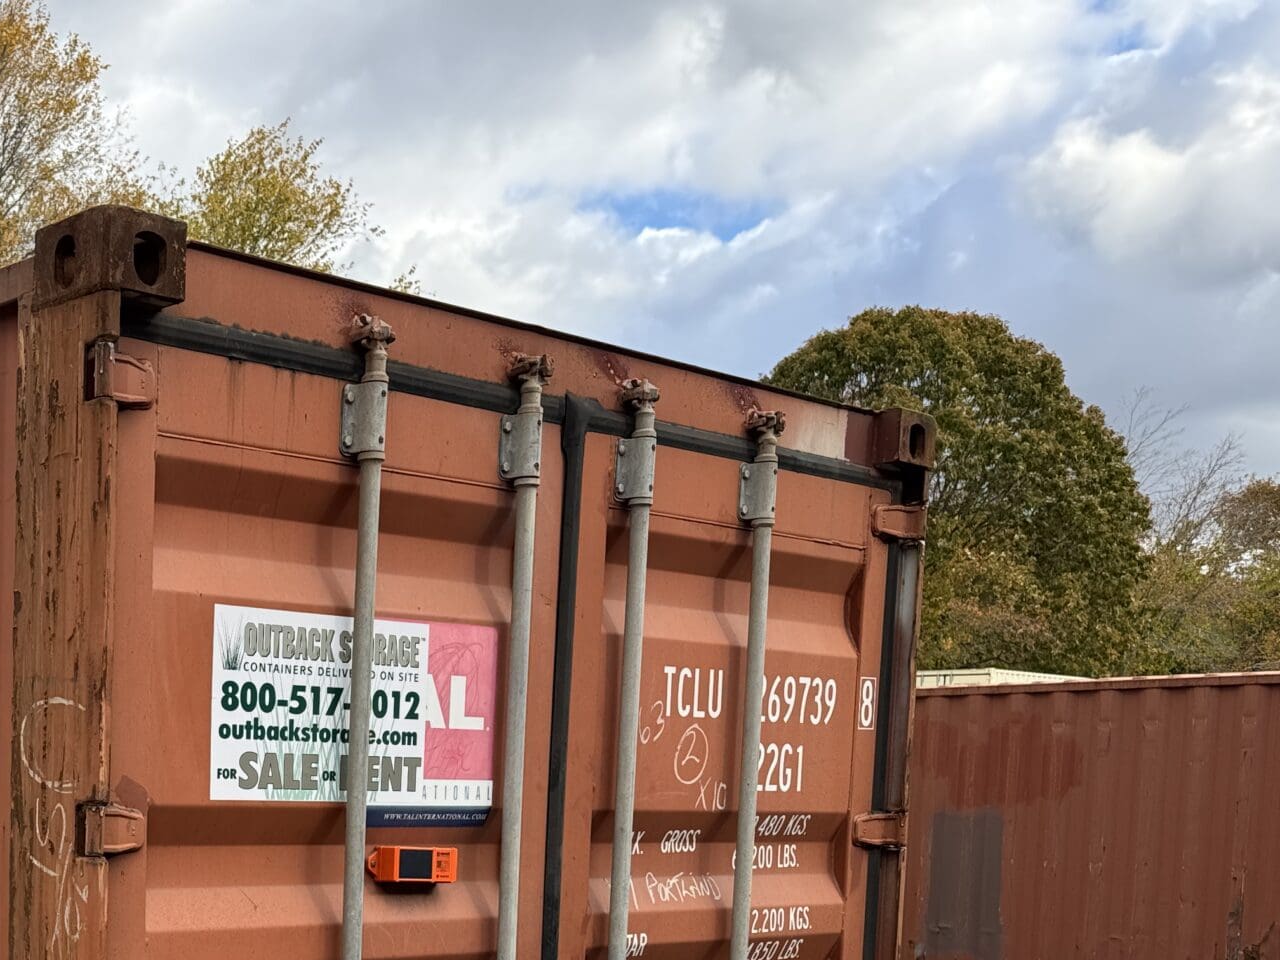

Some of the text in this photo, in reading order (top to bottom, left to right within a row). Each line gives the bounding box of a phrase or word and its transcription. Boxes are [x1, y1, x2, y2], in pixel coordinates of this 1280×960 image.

[243, 622, 420, 668] OUTBACK SRAGE
[243, 661, 419, 683] CONTAINERS DELIVED ON SITE
[220, 680, 420, 720] 800-517-012
[664, 666, 723, 719] TCLU
[860, 680, 873, 727] 8
[218, 717, 418, 746] outbackstorae.com
[217, 768, 237, 780] FOR
[238, 751, 319, 790] SALE
[322, 770, 336, 782] OR
[660, 829, 701, 853] GROSS
[783, 814, 811, 836] KGS.
[777, 844, 800, 868] LBS.
[789, 906, 812, 931] KGS.
[777, 938, 804, 960] LBS.
